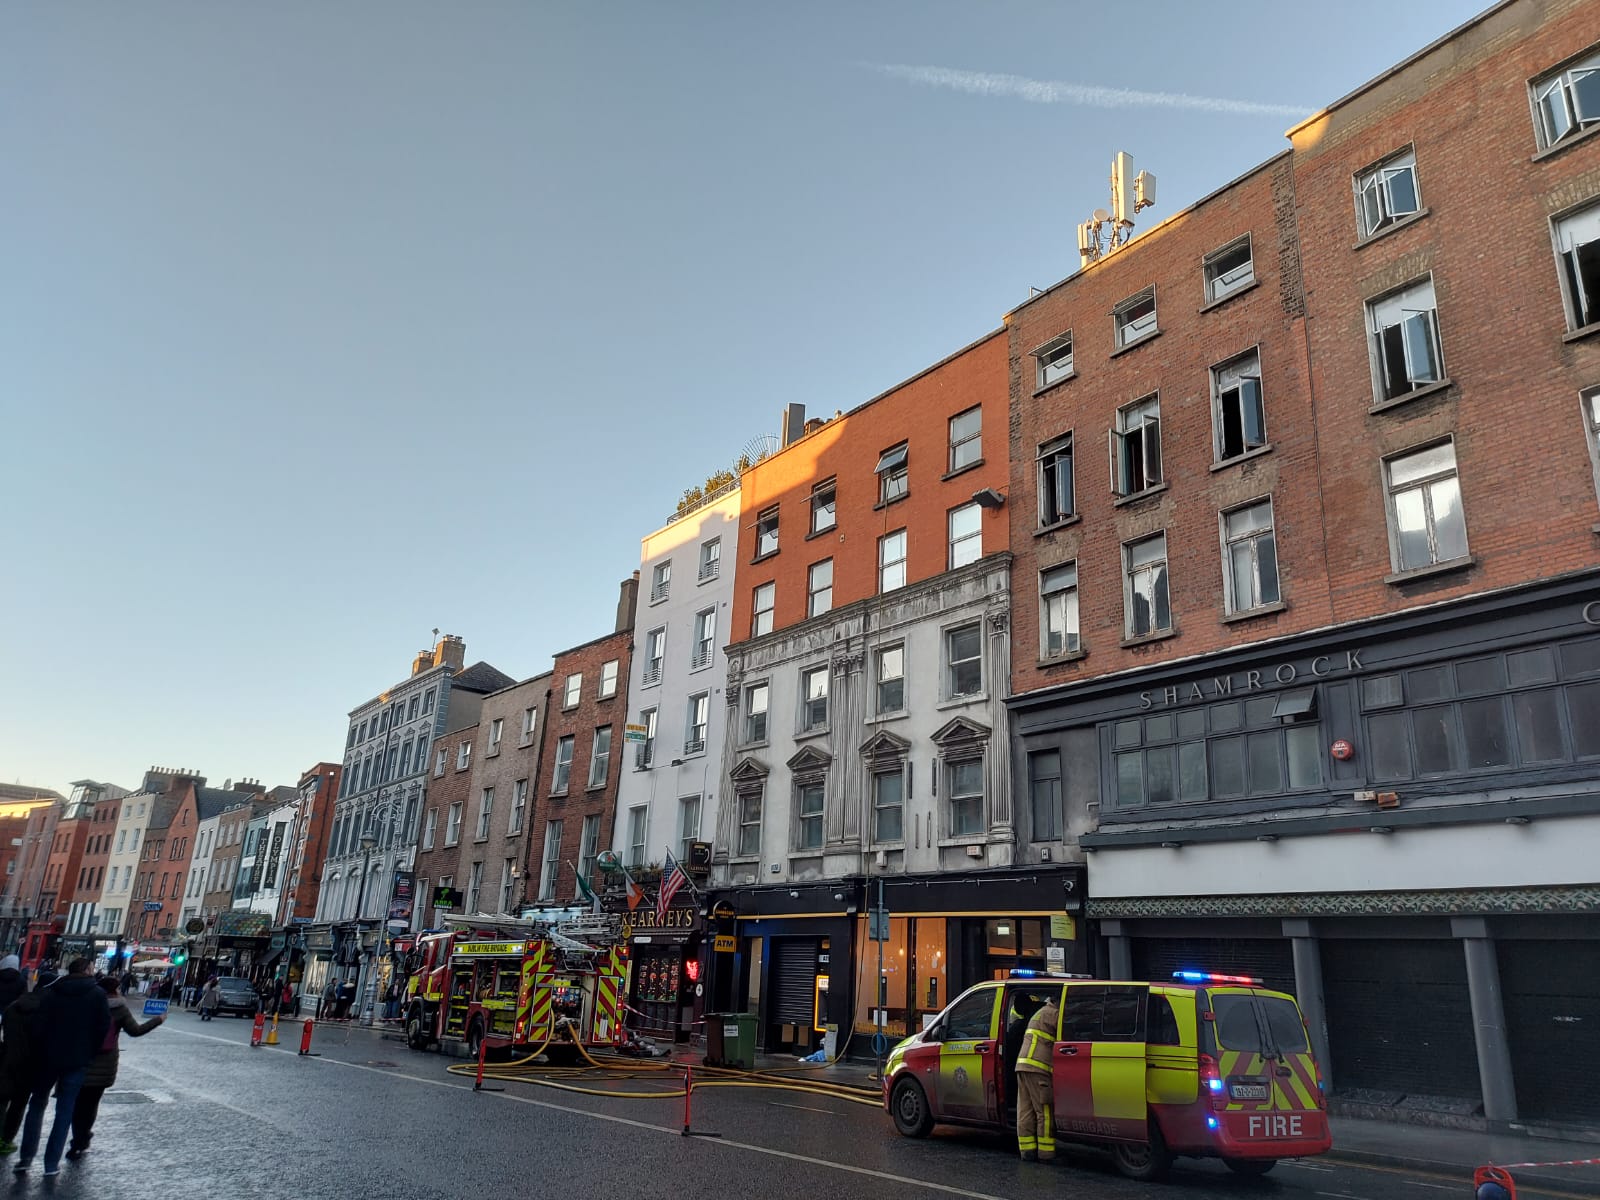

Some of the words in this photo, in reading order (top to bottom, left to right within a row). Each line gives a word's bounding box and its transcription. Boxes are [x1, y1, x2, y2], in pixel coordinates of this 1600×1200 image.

[1139, 648, 1365, 710] SHAMROCK
[252, 837, 267, 884] THEATRE
[266, 836, 282, 884] OLYMPIA
[716, 940, 734, 948] ATM
[1071, 1120, 1120, 1136] BRIGADE
[1248, 1115, 1303, 1137] FIRE
